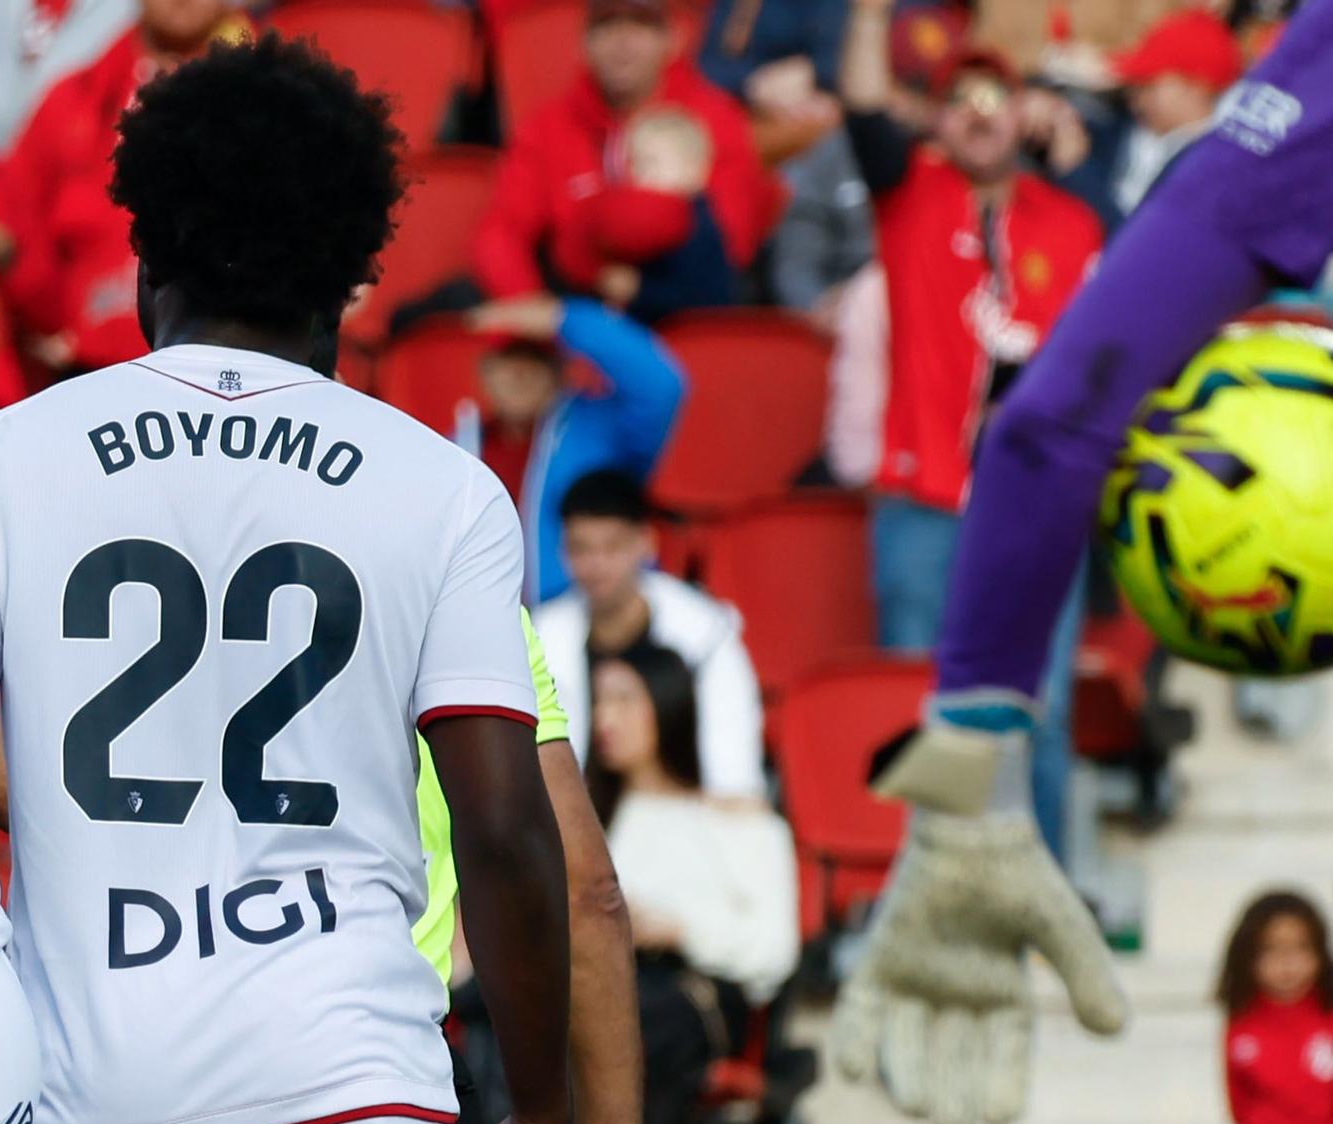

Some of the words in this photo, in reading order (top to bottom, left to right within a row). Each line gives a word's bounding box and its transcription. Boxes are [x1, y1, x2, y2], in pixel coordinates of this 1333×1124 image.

[86, 409, 366, 487] BOYOMO
[60, 537, 364, 828] 22
[108, 867, 338, 970] DIGI
